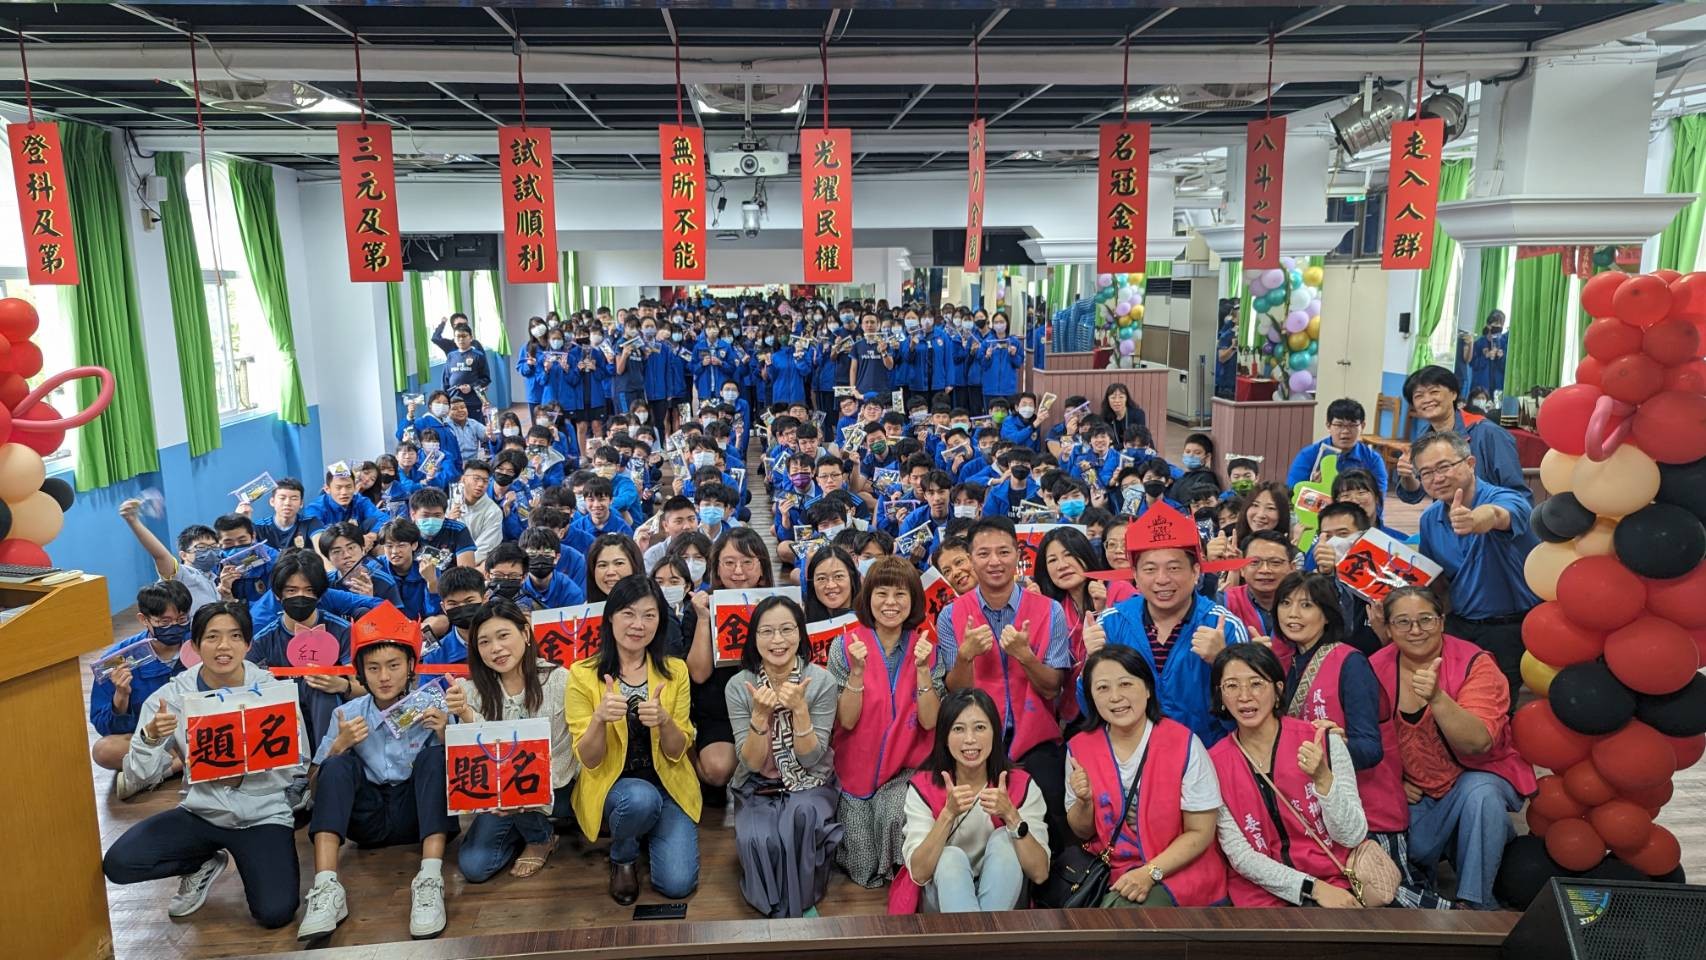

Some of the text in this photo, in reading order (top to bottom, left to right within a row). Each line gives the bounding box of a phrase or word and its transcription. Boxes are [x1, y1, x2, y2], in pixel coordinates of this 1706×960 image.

[22, 134, 64, 275] 登科及第
[352, 136, 390, 272] 三元及第
[510, 138, 544, 272] 試試順利
[670, 136, 698, 269] 無所不能
[813, 139, 842, 272] 光耀民權
[1107, 133, 1139, 264] 名冠金榜
[1251, 133, 1277, 260] 八斗之才
[1392, 130, 1431, 260] 走入人群
[298, 643, 320, 663] 紅
[190, 713, 291, 769] 題名
[449, 749, 541, 800] 題名
[1244, 812, 1268, 851] 委員
